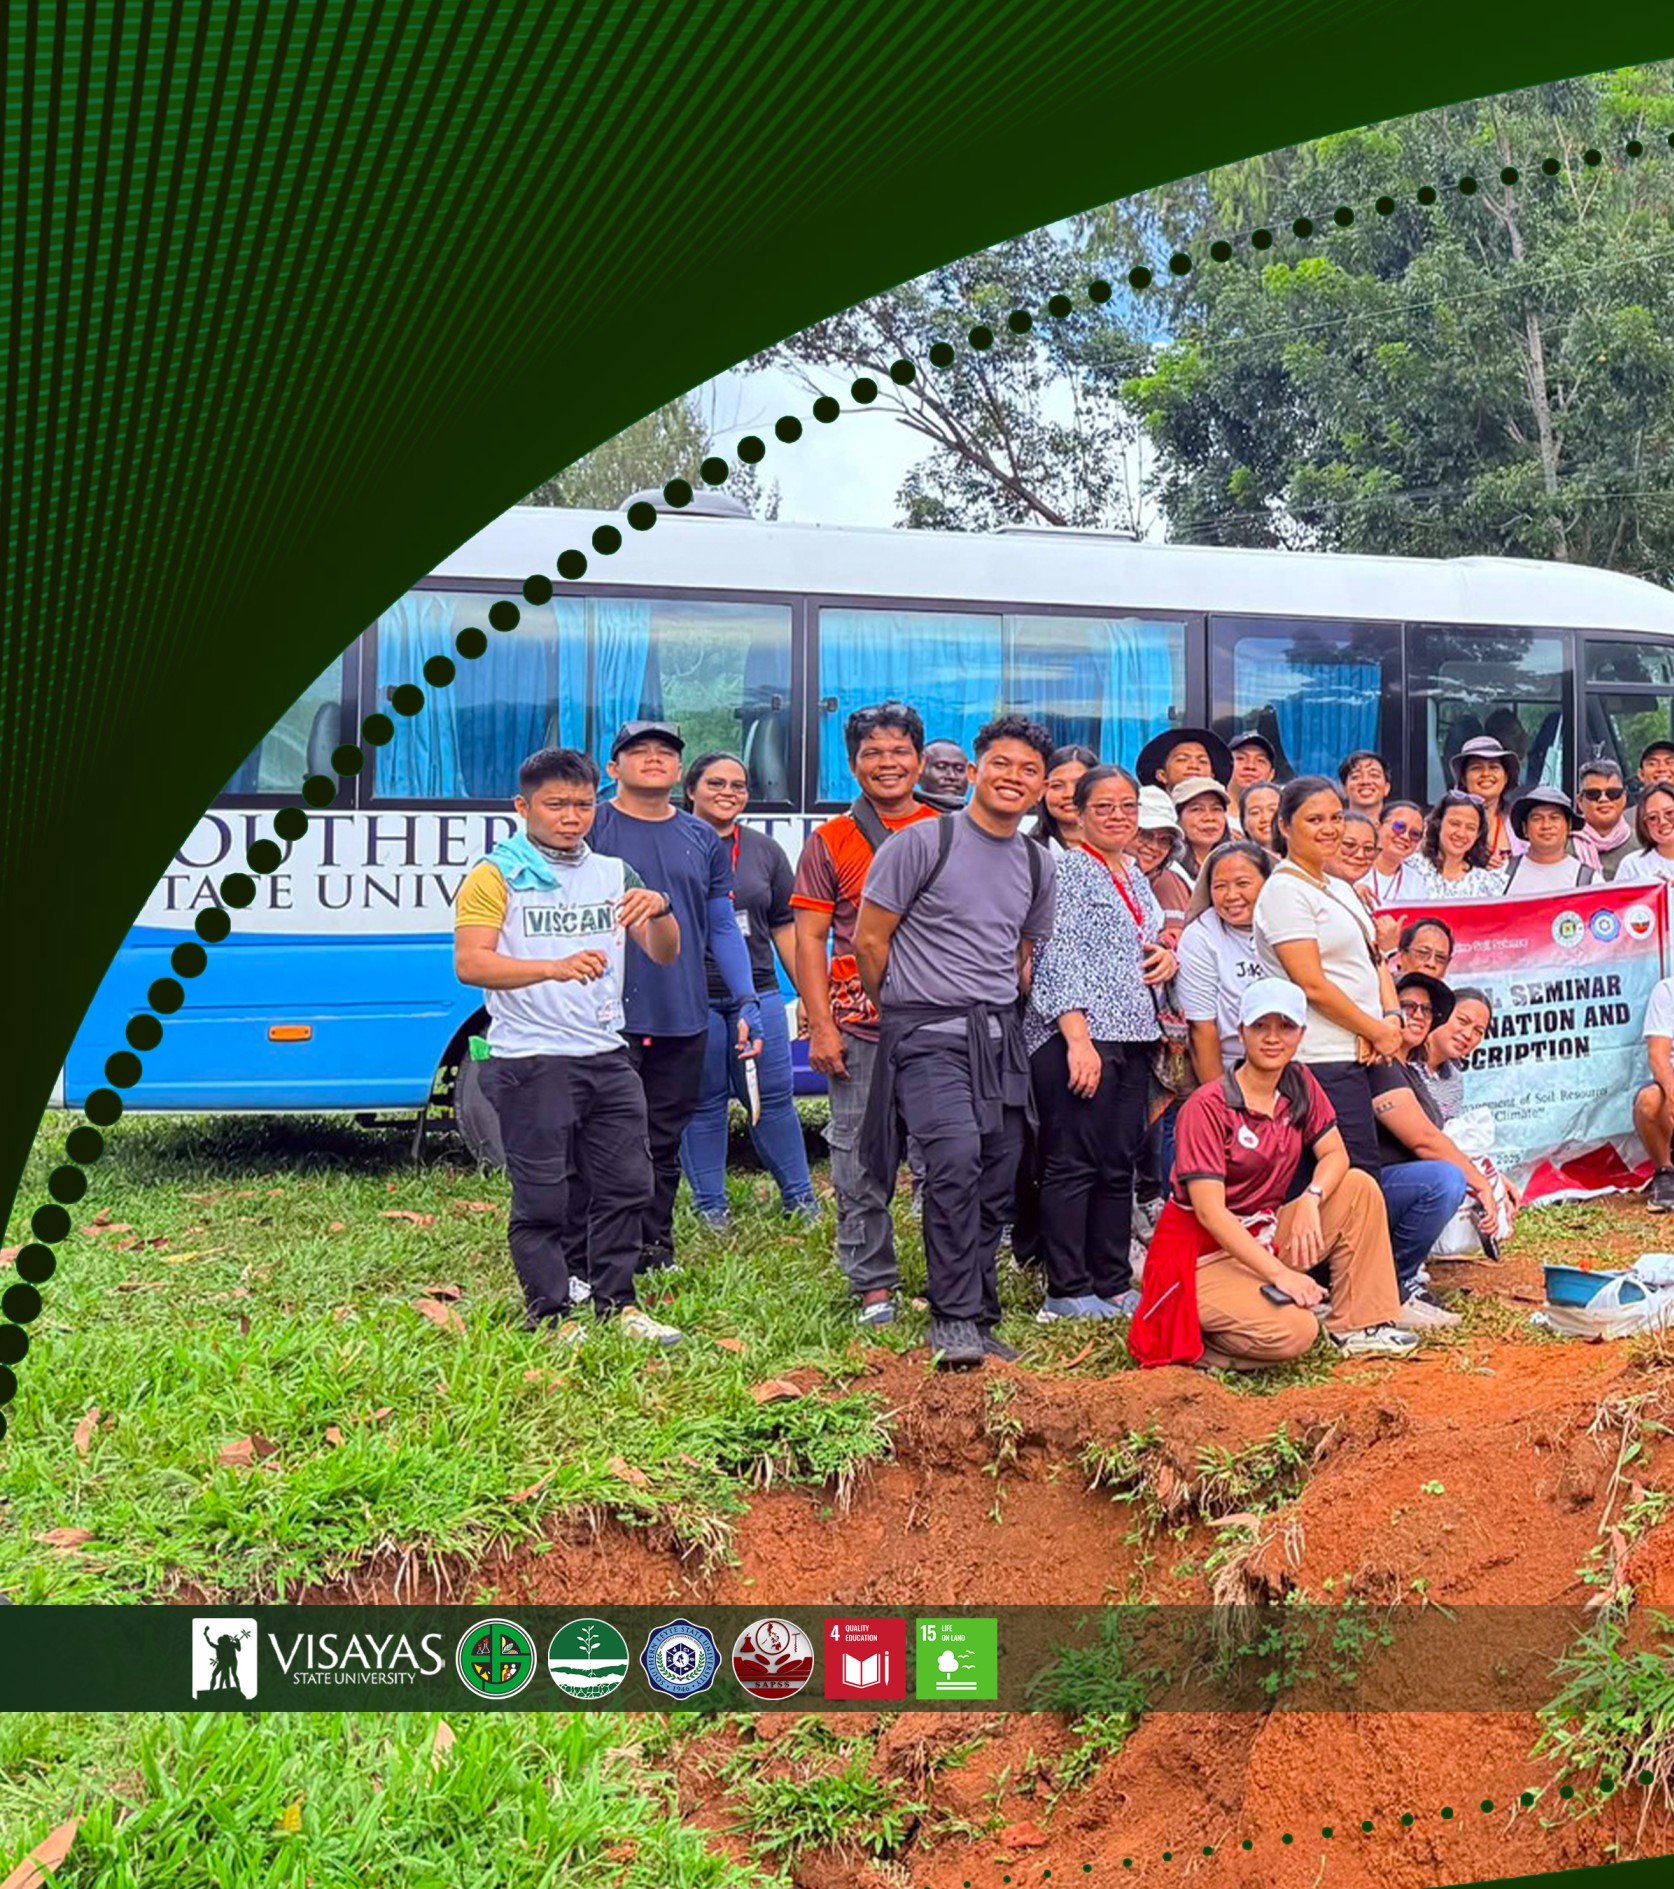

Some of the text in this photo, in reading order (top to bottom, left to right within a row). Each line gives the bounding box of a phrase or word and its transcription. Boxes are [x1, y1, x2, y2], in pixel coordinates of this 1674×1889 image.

[162, 874, 294, 911] TAE
[528, 906, 612, 933] VISCAN
[1509, 974, 1622, 1008] SEMINAR
[1584, 1002, 1631, 1028] AND
